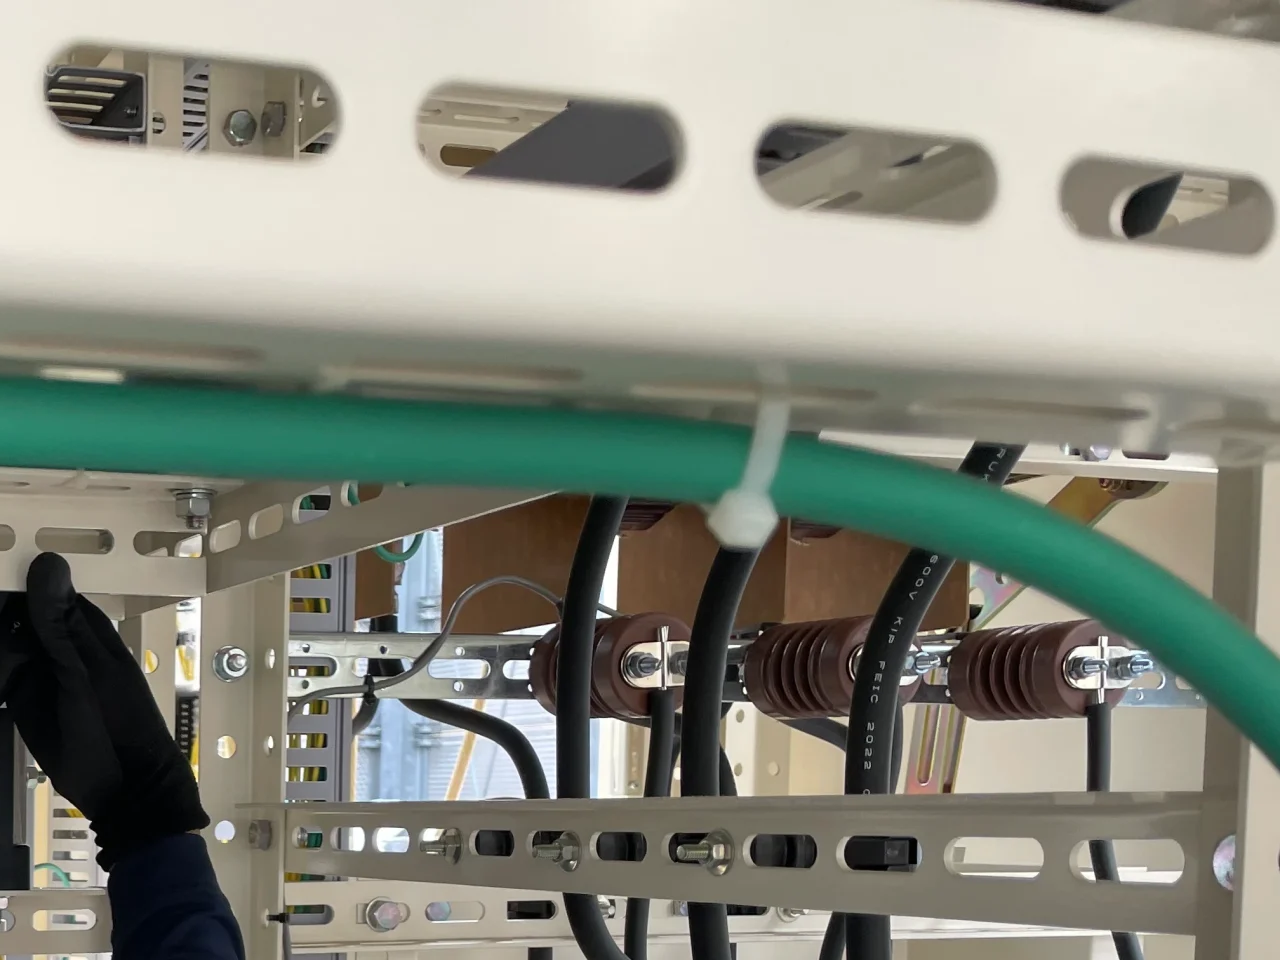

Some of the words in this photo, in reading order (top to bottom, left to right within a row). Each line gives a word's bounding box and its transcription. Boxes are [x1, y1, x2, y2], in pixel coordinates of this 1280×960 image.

[909, 554, 939, 601] 600V
[888, 615, 904, 645] KIP
[870, 660, 896, 704] FEIC
[863, 721, 875, 769] 2022
